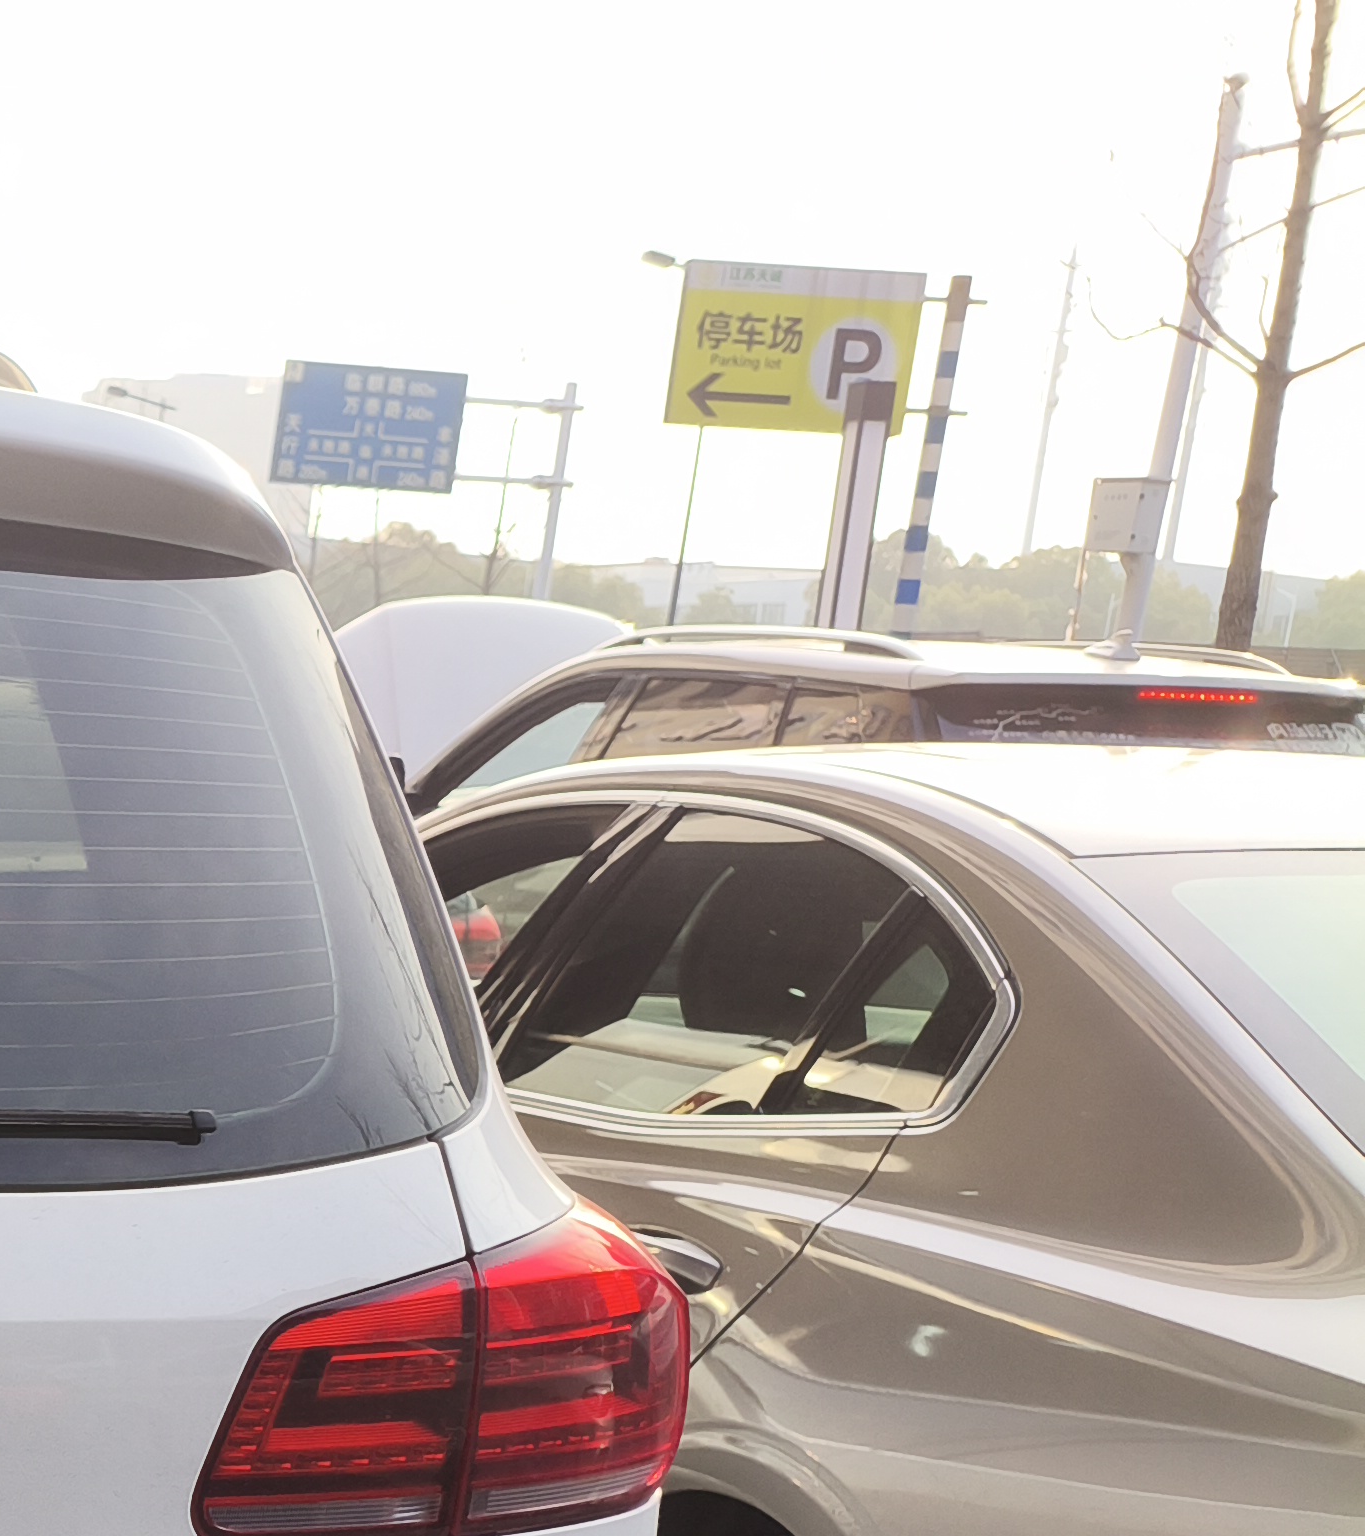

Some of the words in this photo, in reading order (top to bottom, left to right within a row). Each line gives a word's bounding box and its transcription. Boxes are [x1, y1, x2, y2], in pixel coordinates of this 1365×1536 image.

[697, 309, 803, 354] 停车场
[709, 353, 760, 372] Parking
[764, 355, 782, 371] lot
[825, 327, 882, 400] P
